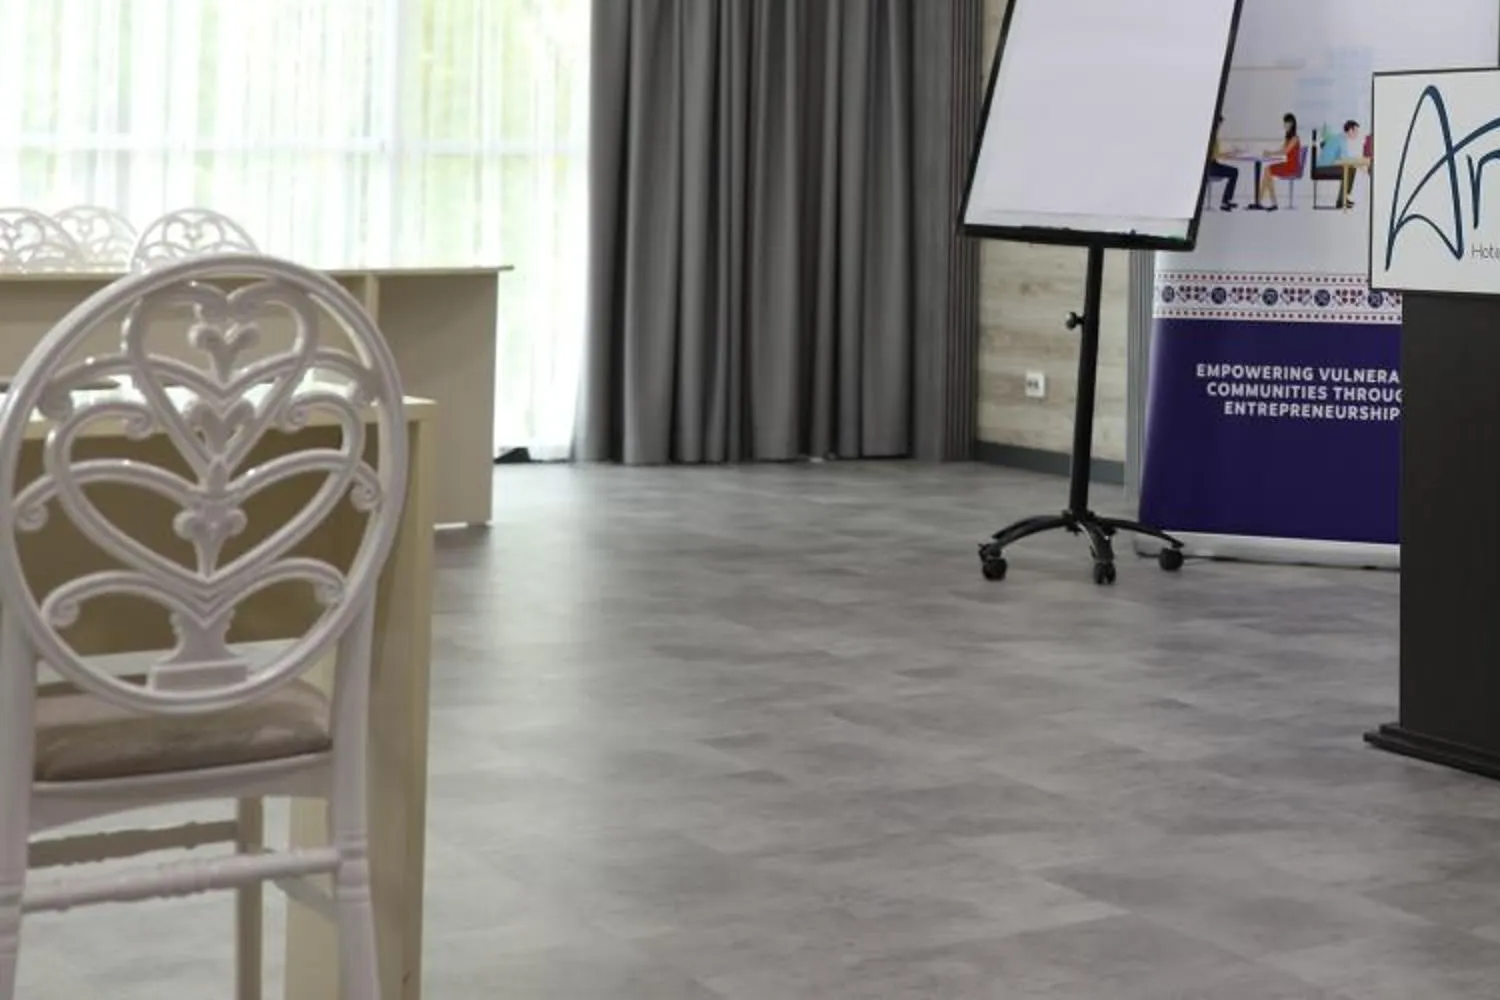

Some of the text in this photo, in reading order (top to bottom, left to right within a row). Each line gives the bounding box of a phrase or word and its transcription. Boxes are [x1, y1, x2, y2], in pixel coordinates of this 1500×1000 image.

[1196, 363, 1400, 384] EMPOWERING VULNERA
[1206, 382, 1328, 400] COMMUNITIES
[1224, 401, 1400, 421] ENTREPRENEURSHIP
